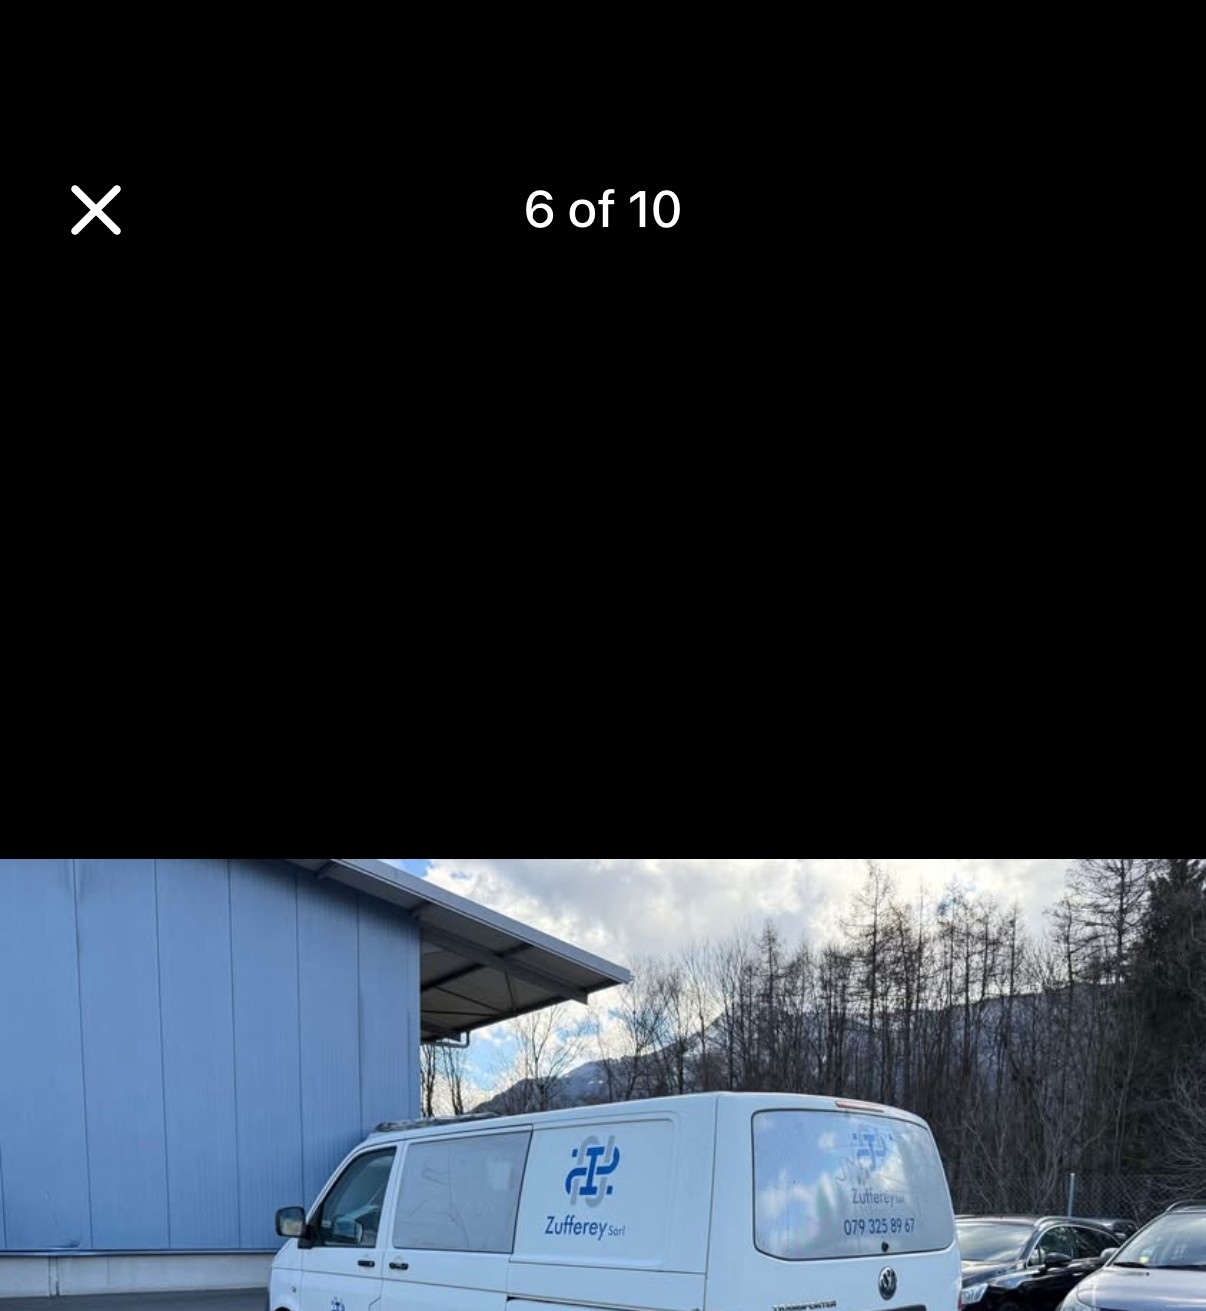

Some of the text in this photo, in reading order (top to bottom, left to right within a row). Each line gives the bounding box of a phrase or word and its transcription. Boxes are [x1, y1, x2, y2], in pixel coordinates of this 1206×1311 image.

[851, 1186, 895, 1208] Zufferey
[545, 1214, 607, 1241] Zufferey
[843, 1217, 915, 1236] 079 325 89 67
